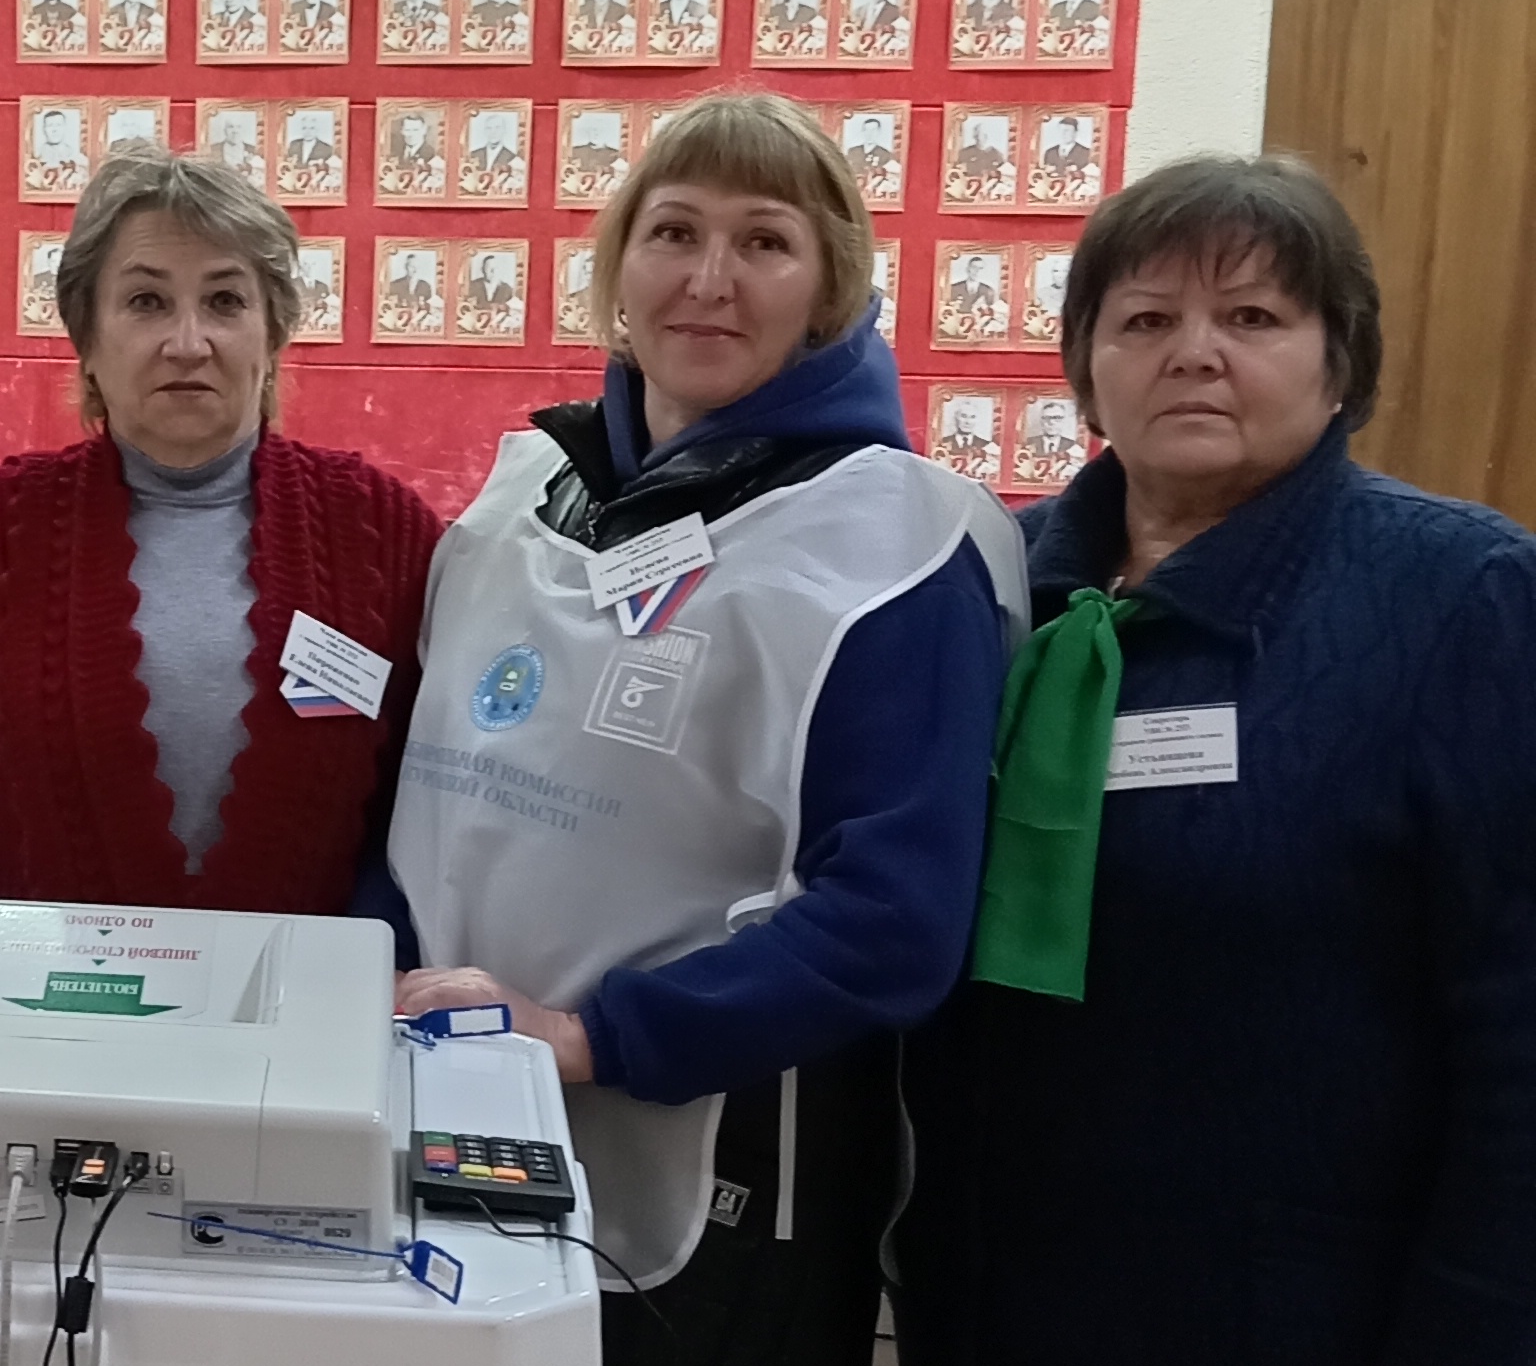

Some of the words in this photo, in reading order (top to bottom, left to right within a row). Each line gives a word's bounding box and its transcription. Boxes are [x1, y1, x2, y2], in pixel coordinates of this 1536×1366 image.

[500, 761, 622, 819] КОМИССИЯ
[483, 785, 579, 833] ОБЛАСТИ
[128, 947, 202, 962] ЛИЦЕВОЙ
[48, 980, 139, 996] БЮЛЛЕТЕНЬ
